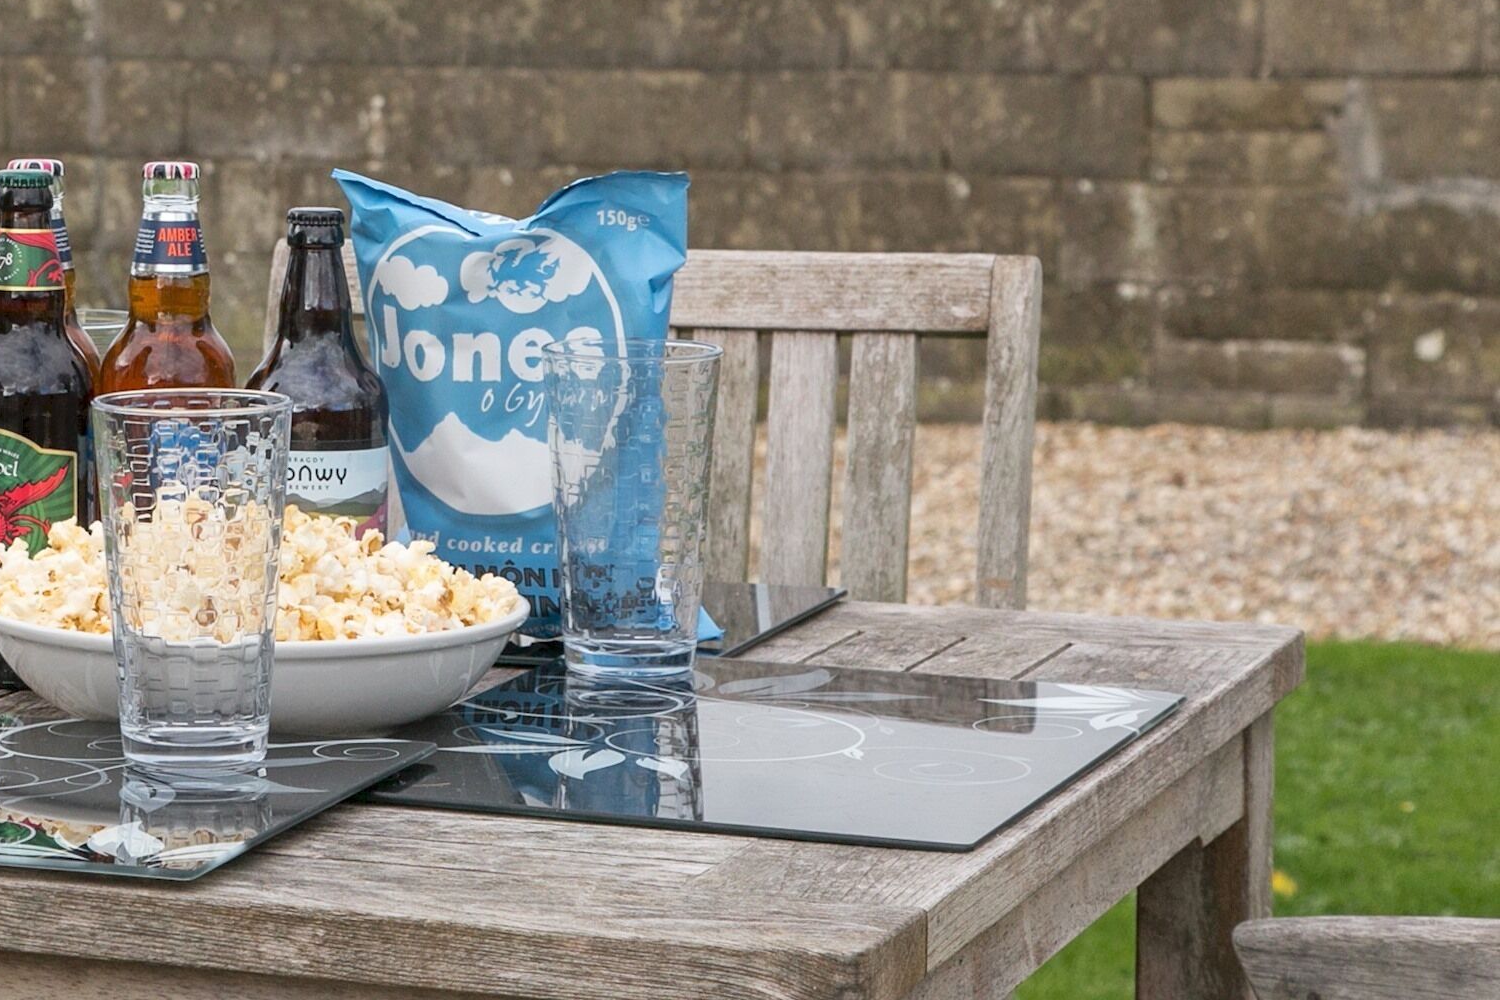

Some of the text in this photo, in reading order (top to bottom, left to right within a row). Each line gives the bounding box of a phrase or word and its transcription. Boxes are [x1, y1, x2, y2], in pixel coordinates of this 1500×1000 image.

[157, 227, 198, 242] AMBER
[167, 242, 193, 257] ALE
[380, 304, 605, 382] Jones
[446, 536, 524, 554] cooked
